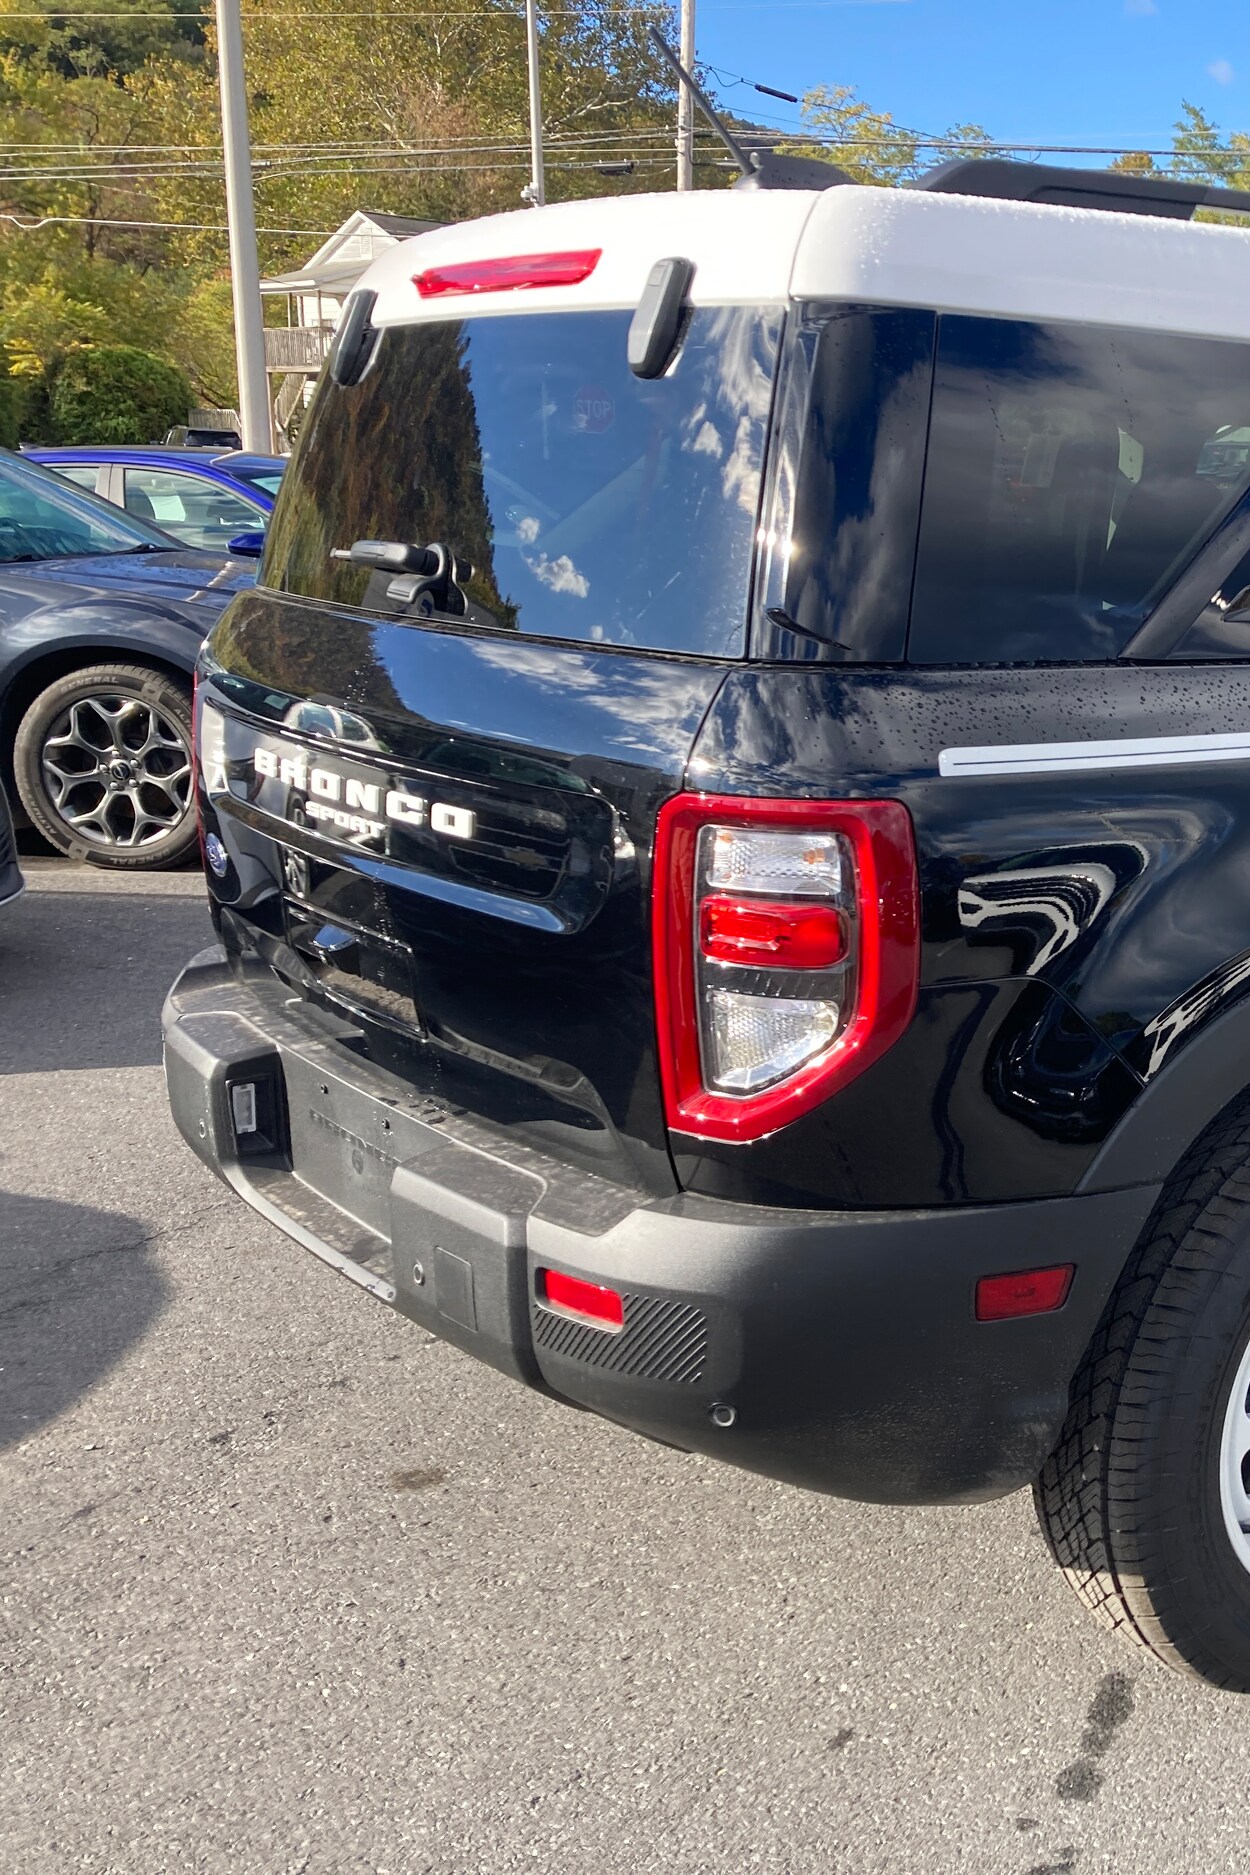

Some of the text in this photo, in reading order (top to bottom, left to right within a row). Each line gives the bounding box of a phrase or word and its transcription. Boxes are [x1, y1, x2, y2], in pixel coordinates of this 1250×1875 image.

[576, 399, 612, 418] STOP
[254, 747, 476, 839] BRONCO
[305, 801, 387, 839] SPORT
